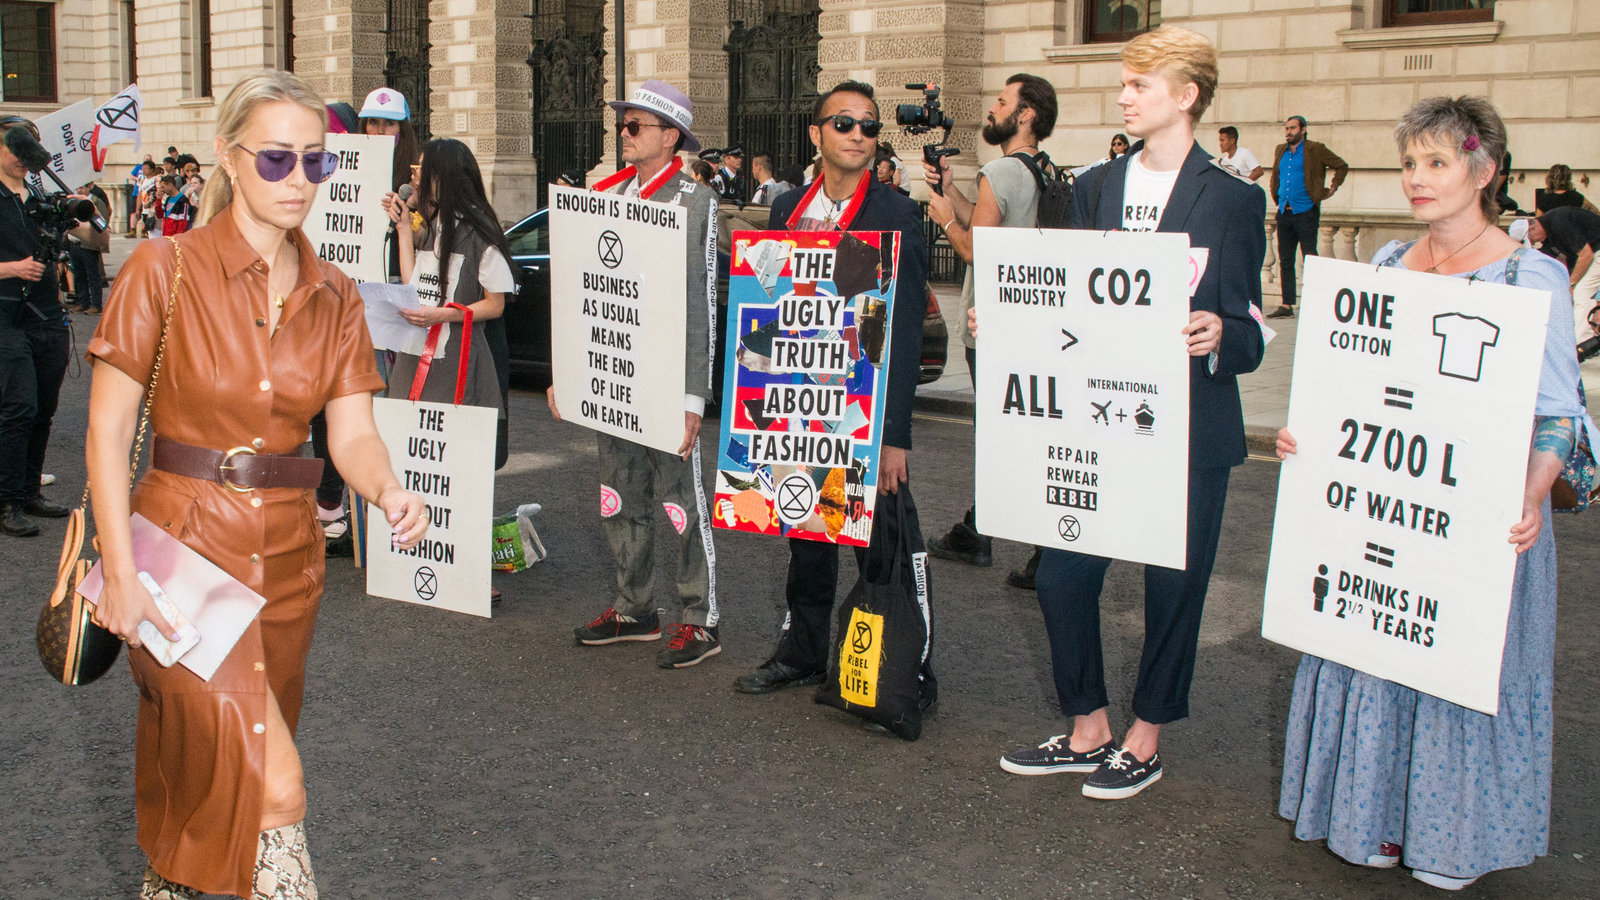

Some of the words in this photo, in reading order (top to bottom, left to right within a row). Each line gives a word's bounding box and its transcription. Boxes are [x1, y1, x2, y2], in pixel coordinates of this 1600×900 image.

[641, 92, 675, 114] FASHION
[61, 123, 77, 154] DON'T
[52, 152, 65, 173] BUY
[339, 150, 360, 170] THE
[330, 183, 361, 203] UGLY
[325, 212, 363, 234] TRUTH
[556, 193, 605, 216] ENOUGH
[610, 200, 619, 218] IS
[626, 203, 680, 230] ENOUGH.
[319, 243, 361, 264] ABOUT
[708, 237, 716, 272] FASHION
[794, 252, 833, 279] THE
[583, 272, 639, 299] BUSINESS
[998, 264, 1066, 287] FASHION
[1088, 267, 1151, 306] CO2
[999, 287, 1066, 307] INDUSTRY
[1334, 287, 1395, 330] ONE
[583, 298, 597, 317] AS
[602, 301, 640, 326] USUAL
[782, 299, 841, 327] UGLY
[591, 326, 631, 351] MEANS
[1330, 330, 1391, 357] COTTON
[588, 351, 608, 371] THE
[612, 357, 635, 378] END
[775, 341, 845, 369] TRUTH
[591, 377, 605, 396] OF
[610, 382, 631, 404] LIFE
[1002, 373, 1063, 419] ALL
[1087, 378, 1158, 395] INTERNATIONAL
[766, 387, 844, 416] ABOUT
[419, 408, 445, 432] THE
[581, 400, 598, 420] ON
[601, 406, 643, 434] EARTH.
[408, 436, 447, 462] UGLY
[752, 434, 850, 466] FASHION
[1048, 445, 1098, 465] REPAIR
[1337, 418, 1428, 478] 2700
[1440, 443, 1457, 487] L
[404, 470, 450, 497] TRUTH
[1047, 466, 1098, 487] REWEAR
[1048, 487, 1096, 509] REBEL
[1326, 481, 1357, 512] OF
[1366, 491, 1450, 539] WATER
[425, 503, 451, 529] OUT
[1337, 569, 1409, 612] DRINKS
[1416, 595, 1438, 622] IN
[1371, 608, 1434, 648] YEARS
[845, 675, 869, 696] LIFE
[851, 668, 861, 677] FOR
